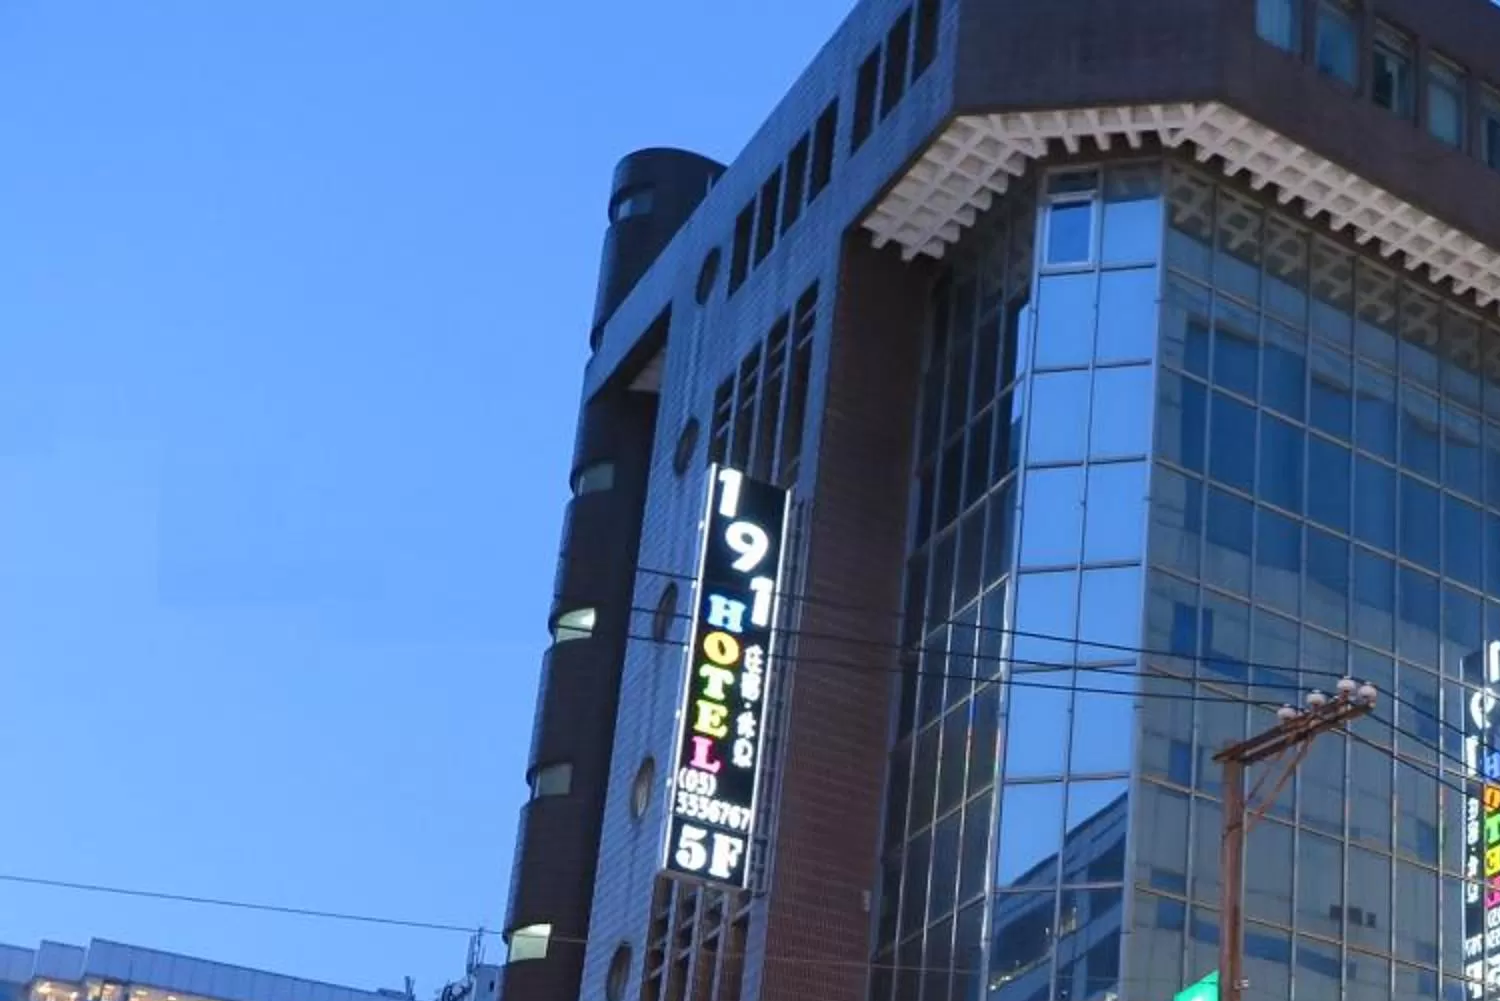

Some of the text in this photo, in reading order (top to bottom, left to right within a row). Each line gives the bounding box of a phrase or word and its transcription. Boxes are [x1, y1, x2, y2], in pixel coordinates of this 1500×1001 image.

[716, 468, 775, 628] 191
[692, 594, 746, 770] HOTEL
[676, 824, 744, 880] 5F
